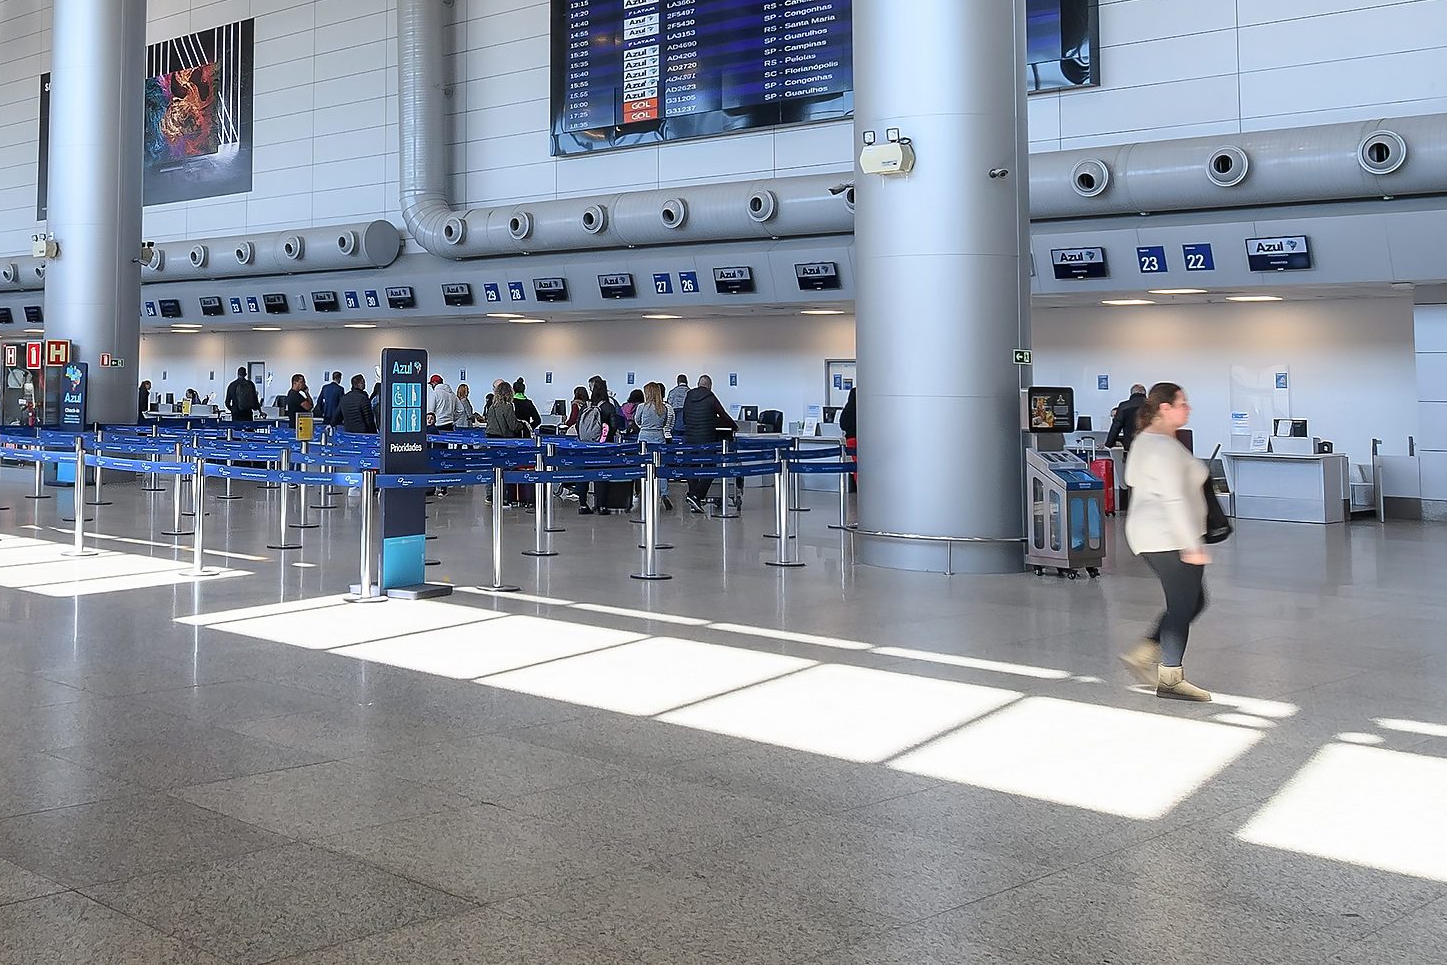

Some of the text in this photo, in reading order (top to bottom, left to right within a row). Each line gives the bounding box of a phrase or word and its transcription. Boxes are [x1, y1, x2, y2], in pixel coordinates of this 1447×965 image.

[570, 1, 589, 9] 13:15
[570, 11, 589, 19] 14:20
[570, 21, 589, 29] 14:40
[633, 7, 655, 15] LATAM
[629, 27, 646, 36] Azul
[763, 2, 777, 11] RS
[629, 17, 646, 25] Azul
[633, 38, 655, 46] LATAM
[764, 14, 777, 22] SP
[784, 3, 833, 18] Congonhas
[625, 49, 646, 59] Azul
[764, 25, 777, 33] RS
[785, 20, 809, 29] Santa
[811, 14, 836, 24] Maria
[625, 59, 646, 69] Azul
[784, 28, 828, 41] Guarulhos
[625, 70, 646, 79] Azul
[667, 62, 697, 72] AD2720
[784, 40, 827, 52] Campinas
[625, 81, 646, 90] Azul
[764, 59, 777, 67] RS
[625, 91, 646, 100] Azul
[764, 70, 777, 78] SC
[785, 61, 839, 75] Florianópolis
[632, 101, 651, 109] GOL
[764, 82, 777, 90] SP
[784, 73, 833, 86] Congonhas
[764, 93, 777, 101] SP
[784, 86, 828, 97] Guarulhos
[1257, 242, 1283, 252] Azul
[1060, 252, 1084, 262] Azul
[1187, 255, 1205, 269] 22
[802, 265, 820, 275] Azul
[1141, 257, 1158, 271] 23
[720, 270, 736, 279] Azul
[656, 281, 666, 292] 27
[682, 281, 693, 291] 26
[487, 290, 496, 301] 29
[511, 289, 521, 300] 28
[7, 348, 14, 364] H
[50, 344, 65, 362] H
[393, 361, 413, 374] Azul
[64, 393, 81, 403] Azul
[391, 443, 422, 453] Prioridades
